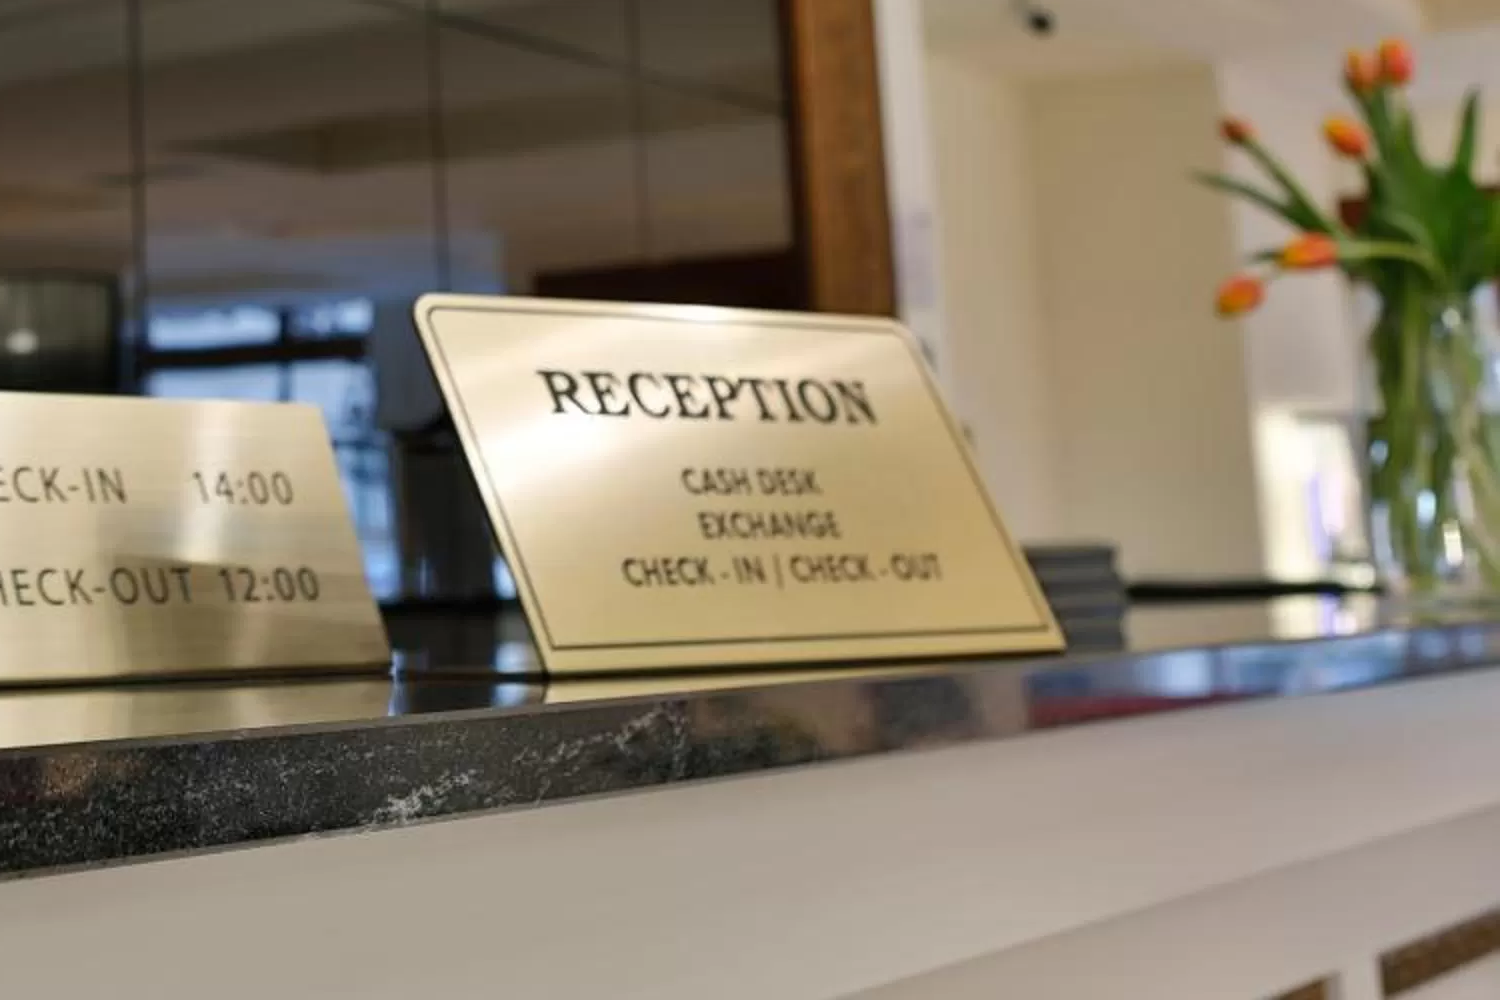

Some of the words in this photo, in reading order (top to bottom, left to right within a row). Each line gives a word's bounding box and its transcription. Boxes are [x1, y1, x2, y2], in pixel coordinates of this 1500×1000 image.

[535, 369, 880, 426] RECEPTION
[192, 470, 294, 505] 14:00
[680, 467, 752, 496] CASH
[755, 467, 823, 496] DESK
[697, 510, 842, 540] EXCHANGE
[218, 566, 320, 604] 12:00
[621, 556, 715, 587] CHECK
[731, 556, 767, 584] IN
[789, 553, 877, 584] CHECK
[889, 552, 943, 580] OUT
